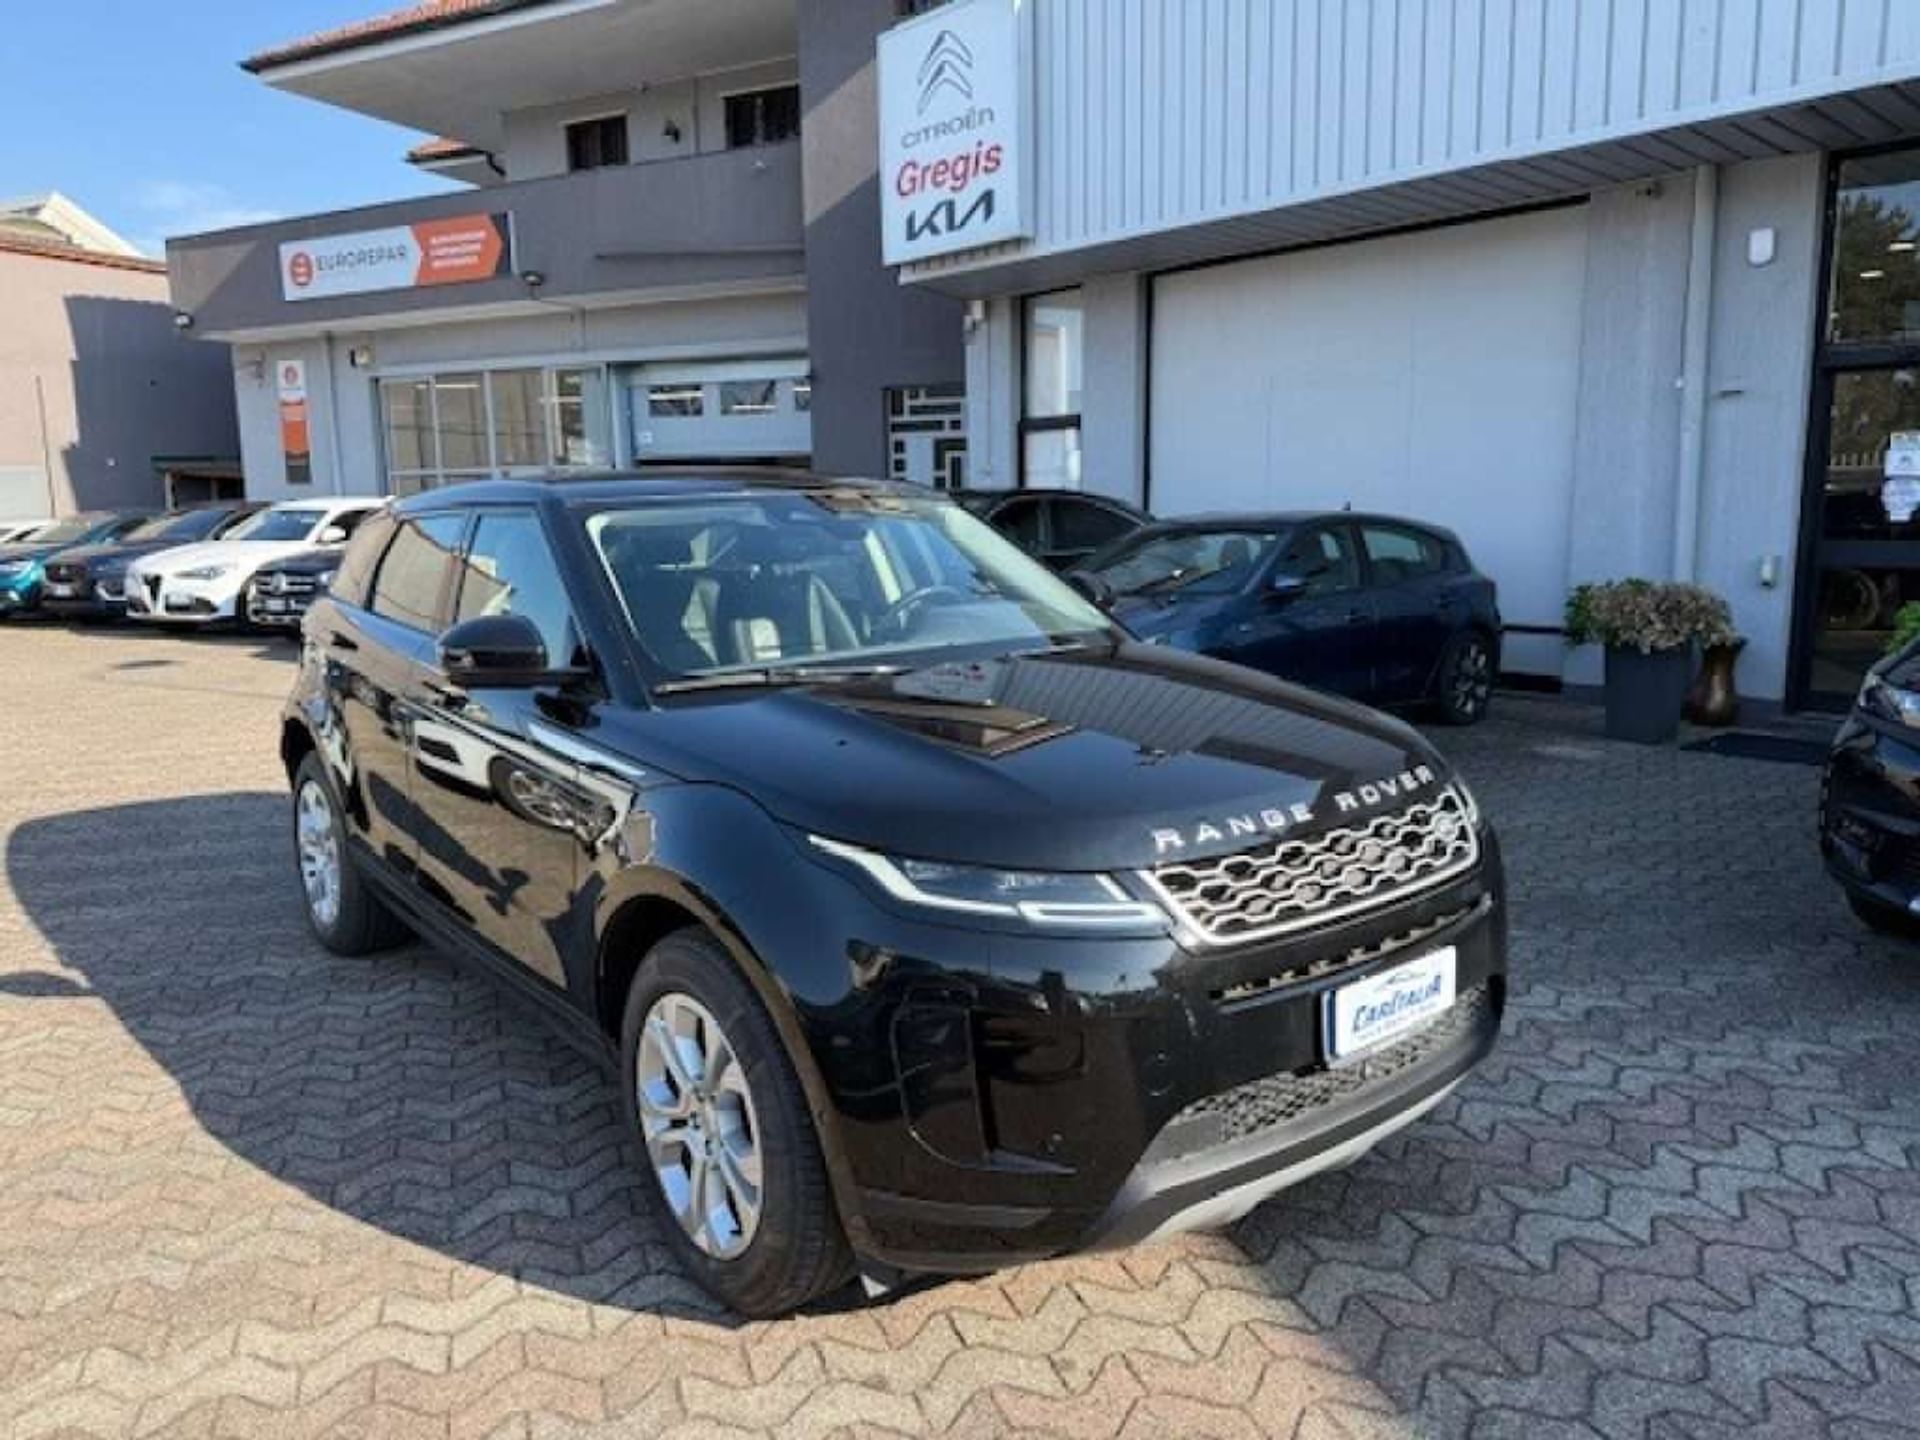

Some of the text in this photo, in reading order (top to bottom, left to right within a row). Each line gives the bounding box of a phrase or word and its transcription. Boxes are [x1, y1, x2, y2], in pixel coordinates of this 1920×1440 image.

[896, 140, 1003, 197] Gregis
[905, 188, 994, 241] KIA
[315, 244, 407, 272] EUROREPAR
[1152, 765, 1435, 852] RANGE ROVER
